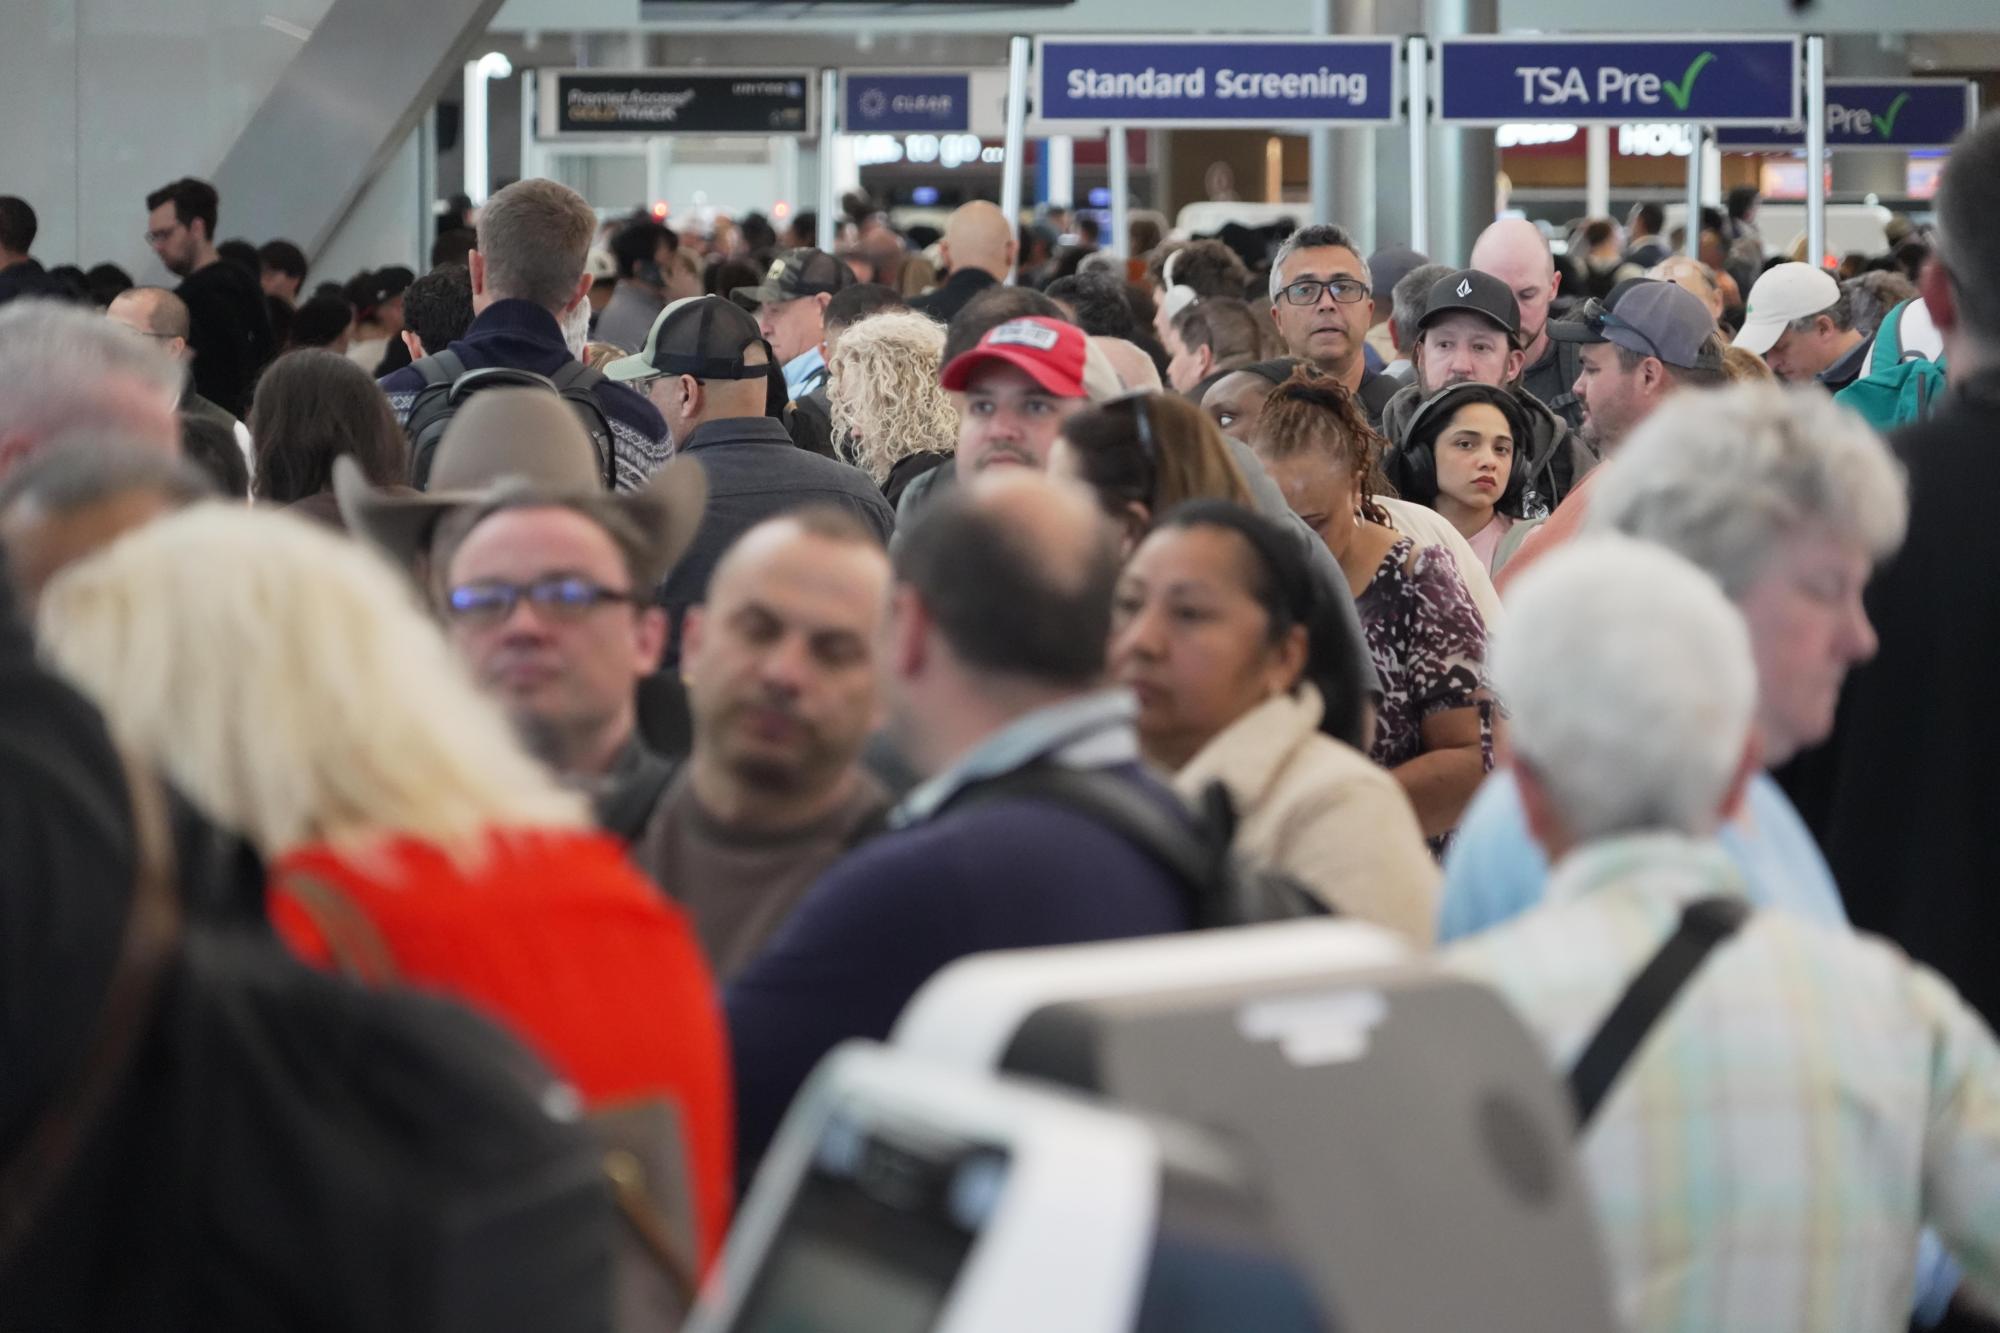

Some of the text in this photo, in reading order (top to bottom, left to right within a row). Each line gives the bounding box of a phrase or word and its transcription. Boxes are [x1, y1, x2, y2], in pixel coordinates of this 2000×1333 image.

[1067, 67, 1367, 104] Standard Screening
[1515, 67, 1661, 104] TSA Pre
[1826, 103, 1872, 134] Pre
